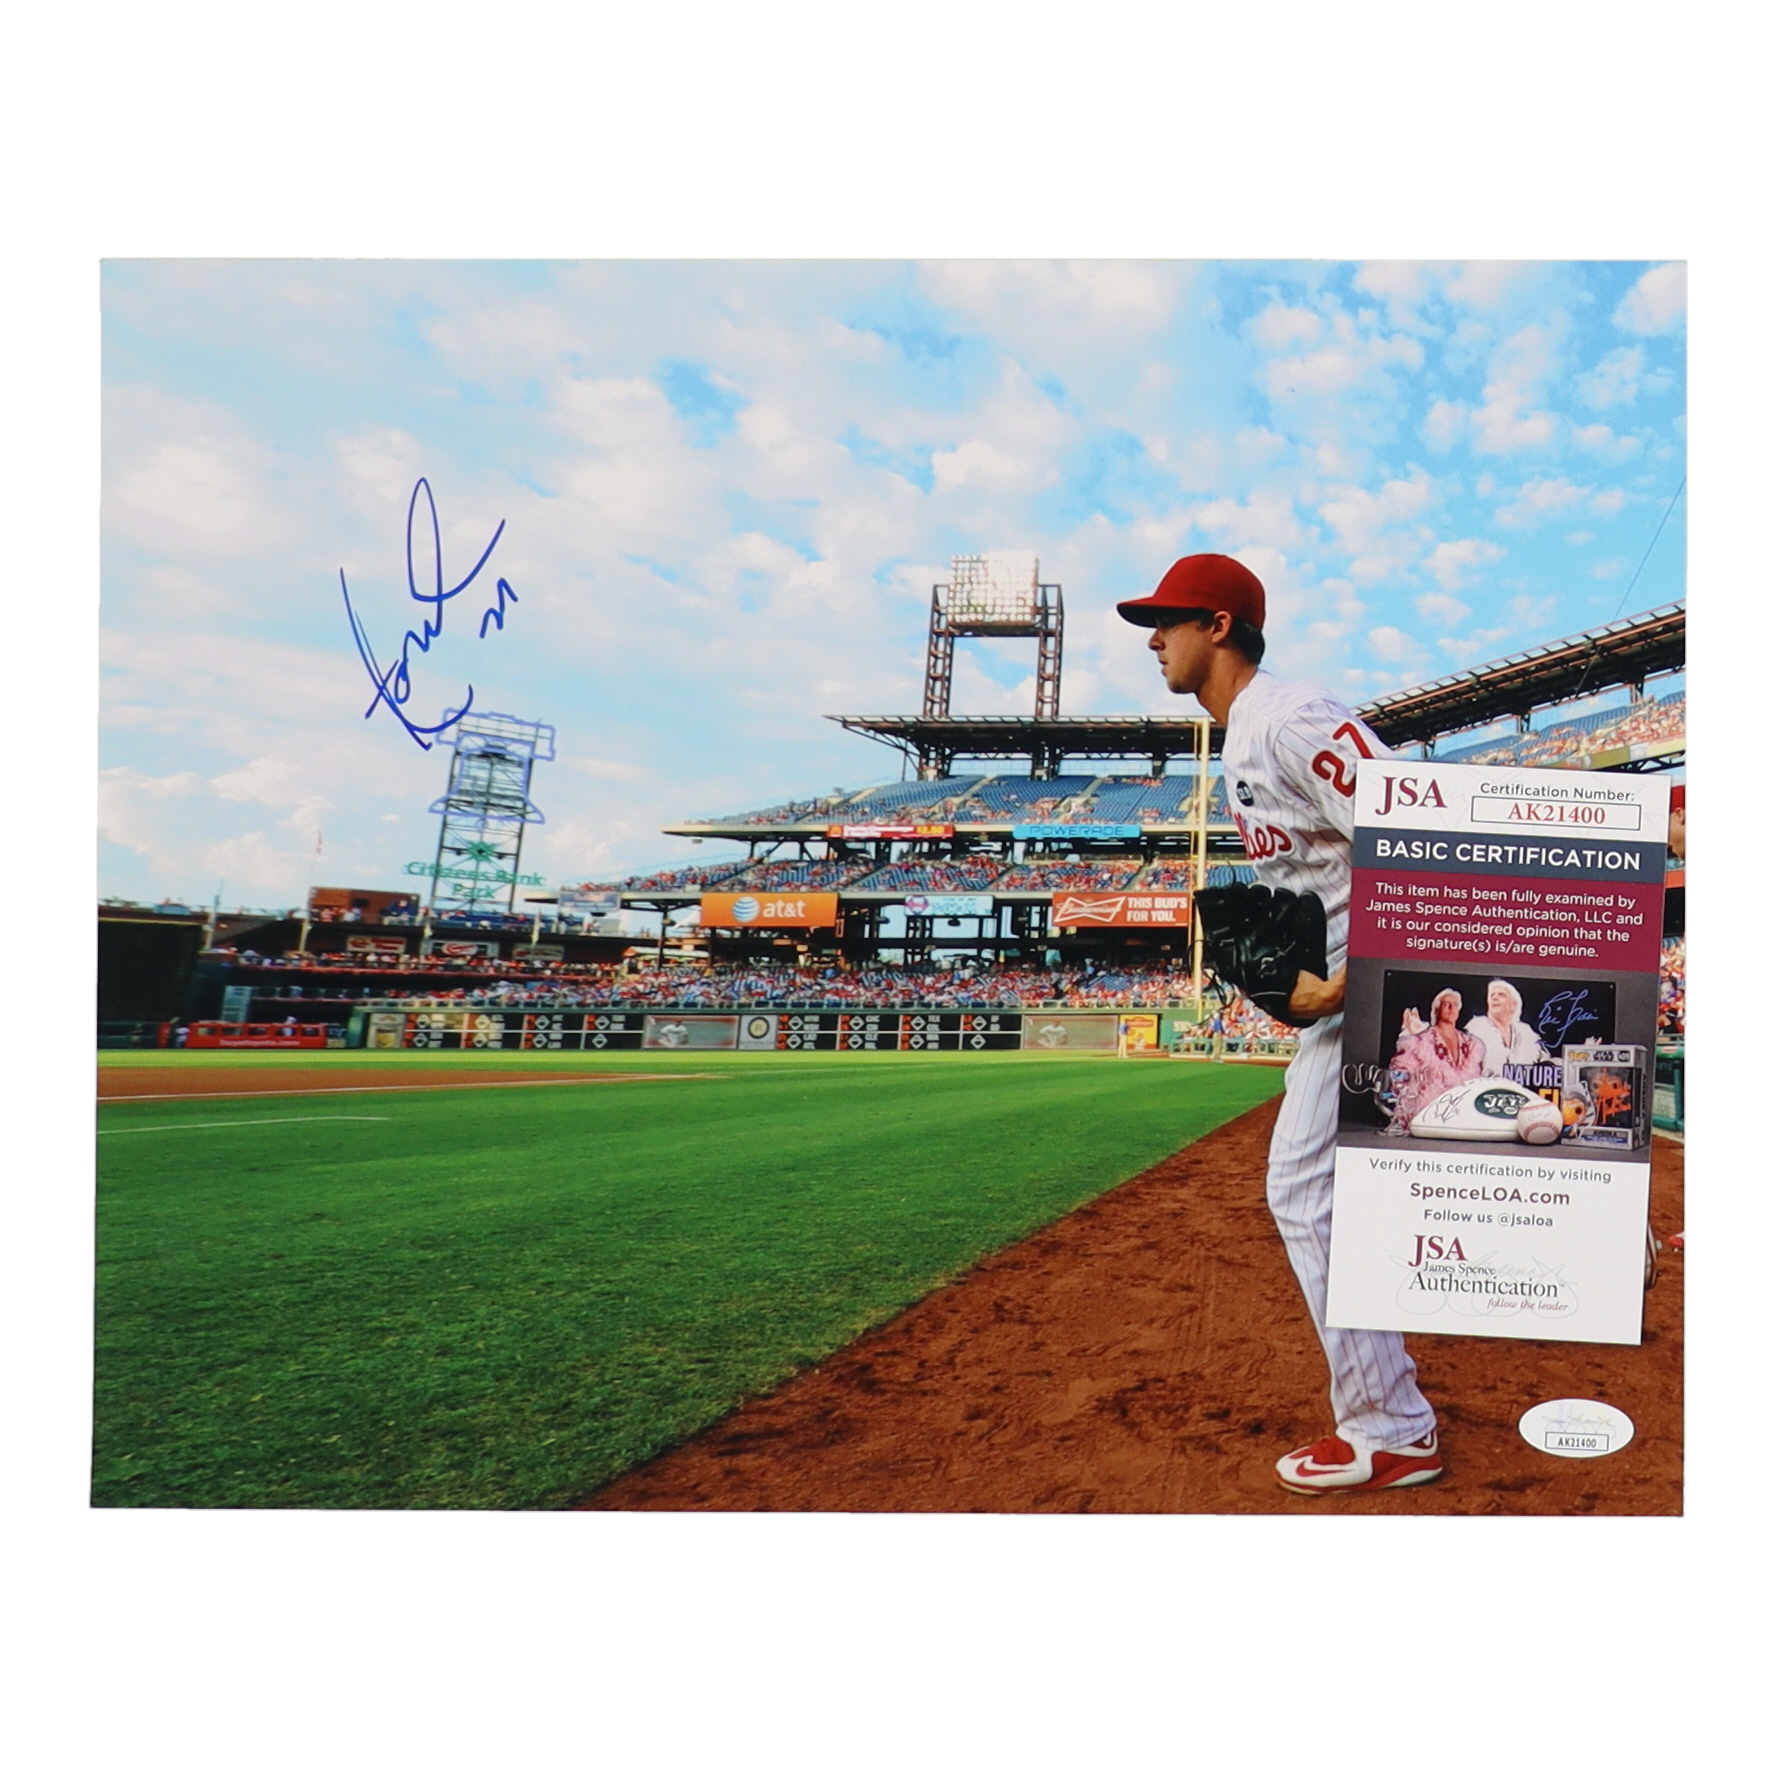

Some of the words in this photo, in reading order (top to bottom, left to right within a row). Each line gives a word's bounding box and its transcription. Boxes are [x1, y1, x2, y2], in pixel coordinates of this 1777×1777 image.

[1312, 721, 1375, 799] 27
[1375, 776, 1447, 816] JSA
[1480, 782, 1570, 798] Certification
[1573, 787, 1635, 802] Number:
[1508, 804, 1606, 825] AK21400
[1029, 826, 1124, 836] POWERADE
[1376, 838, 1449, 861] BASIC
[1455, 843, 1641, 871] CERTIFICATION
[405, 860, 490, 880] Citizens
[495, 868, 546, 887] Bank
[452, 882, 495, 899] Park
[1127, 896, 1153, 909] THIS
[1154, 896, 1188, 909] BUD'S
[1375, 882, 1404, 896] This
[1407, 883, 1439, 898] item
[1443, 885, 1468, 900] has
[1471, 886, 1508, 902] been
[1511, 888, 1541, 906] fully
[1545, 891, 1614, 907] examined
[1617, 894, 1636, 910] by
[762, 900, 806, 918] at&t
[1127, 910, 1149, 922] FOR
[1151, 910, 1176, 922] YOU.
[1365, 899, 1411, 914] James
[1415, 901, 1468, 919] Spence
[1471, 904, 1580, 924] Authentication,
[1584, 910, 1613, 924] LLC
[1616, 911, 1643, 926] and
[1377, 916, 1388, 930] it
[1391, 917, 1403, 931] is
[1406, 920, 1432, 933] our
[1434, 919, 1513, 937] considered
[1516, 923, 1570, 942] opinion
[1574, 926, 1602, 941] that
[1605, 928, 1631, 943] the
[1406, 935, 1492, 956] signature(s)
[1495, 939, 1536, 955] is/are
[1538, 943, 1600, 959] genuine.
[1503, 1063, 1562, 1088] NATURE
[1369, 1157, 1412, 1176] Verify
[1416, 1159, 1443, 1173] this
[1446, 1162, 1533, 1179] certification
[1537, 1166, 1557, 1182] by
[1560, 1167, 1612, 1184] visiting
[1410, 1182, 1571, 1206] SpenceLOA.com
[1423, 1209, 1473, 1223] Follow
[1477, 1213, 1494, 1224] us
[1497, 1211, 1554, 1228] @jsaloa
[1408, 1235, 1468, 1268] JSA
[1423, 1260, 1456, 1274] James
[1458, 1262, 1496, 1277] Spence
[1408, 1271, 1559, 1298] Authentication
[1486, 1297, 1517, 1309] follow
[1520, 1299, 1535, 1310] the
[1537, 1300, 1569, 1312] leader
[1557, 1436, 1597, 1449] AK21400
